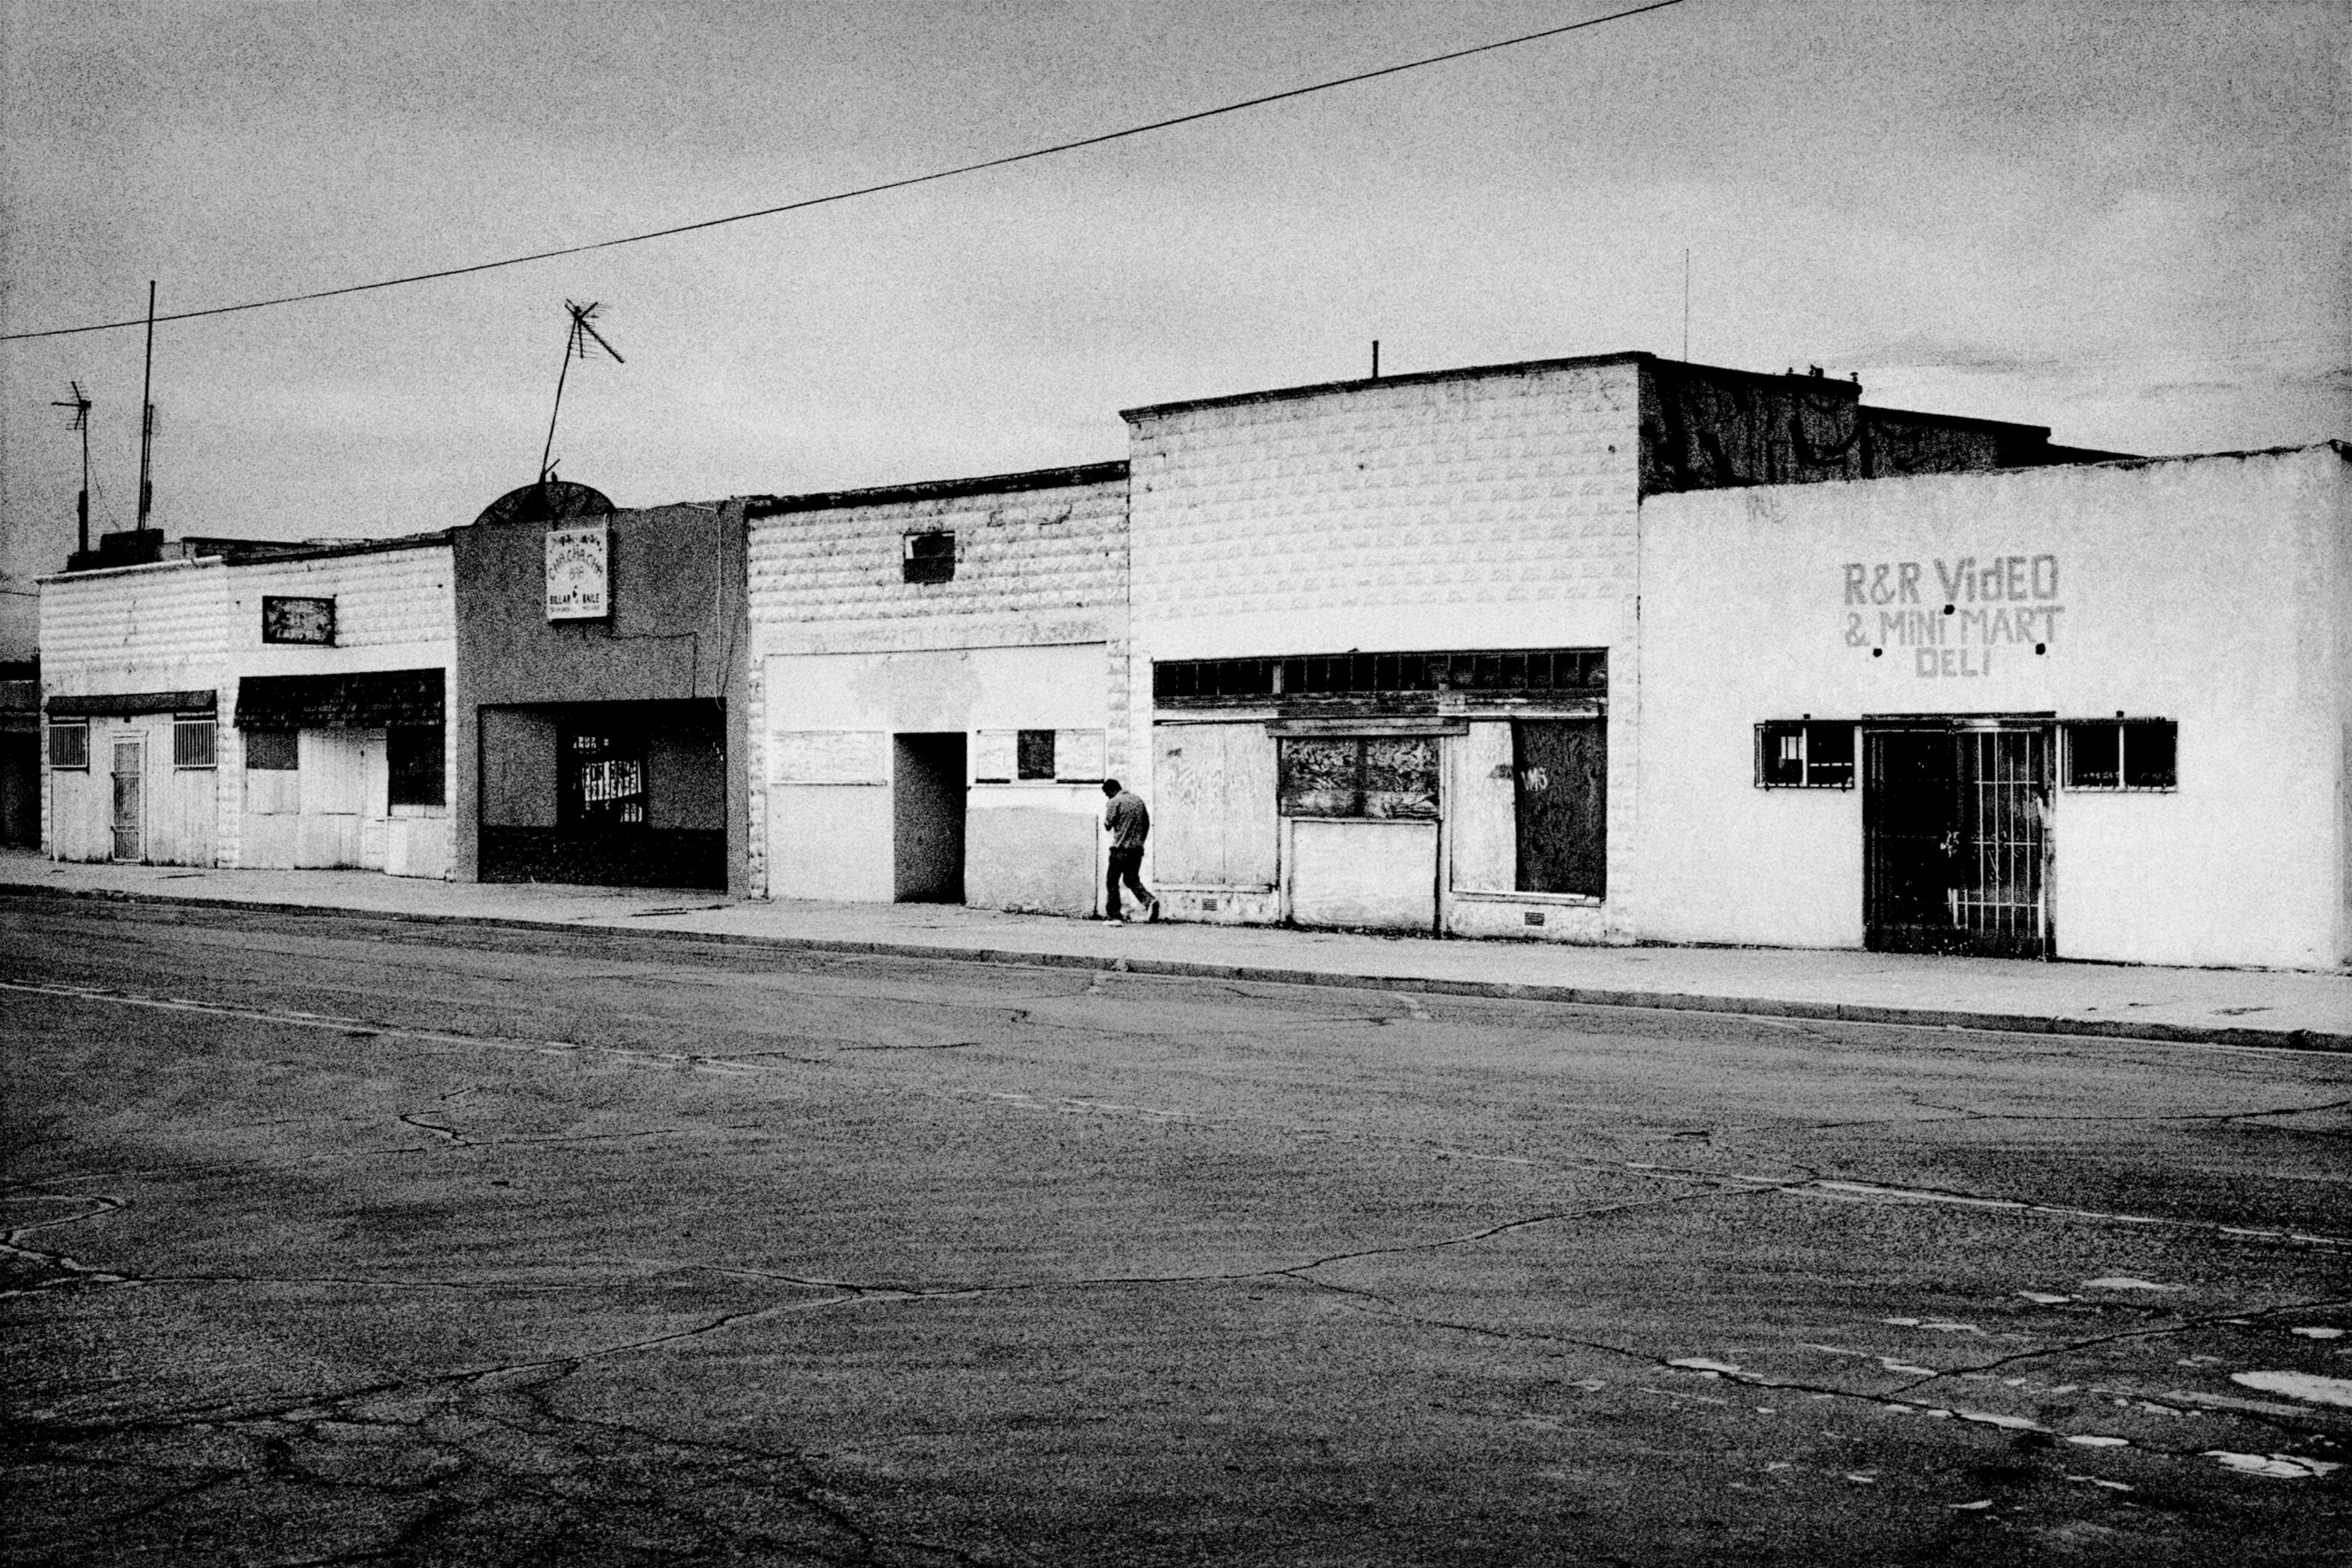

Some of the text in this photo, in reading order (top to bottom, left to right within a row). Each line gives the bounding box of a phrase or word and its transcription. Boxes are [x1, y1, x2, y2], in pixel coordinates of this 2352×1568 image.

[550, 595, 570, 605] BILLAR
[1841, 563, 1921, 605] R&R
[1844, 612, 1870, 648] &
[1958, 606, 2066, 645] MART
[1915, 647, 1991, 678] DELI
